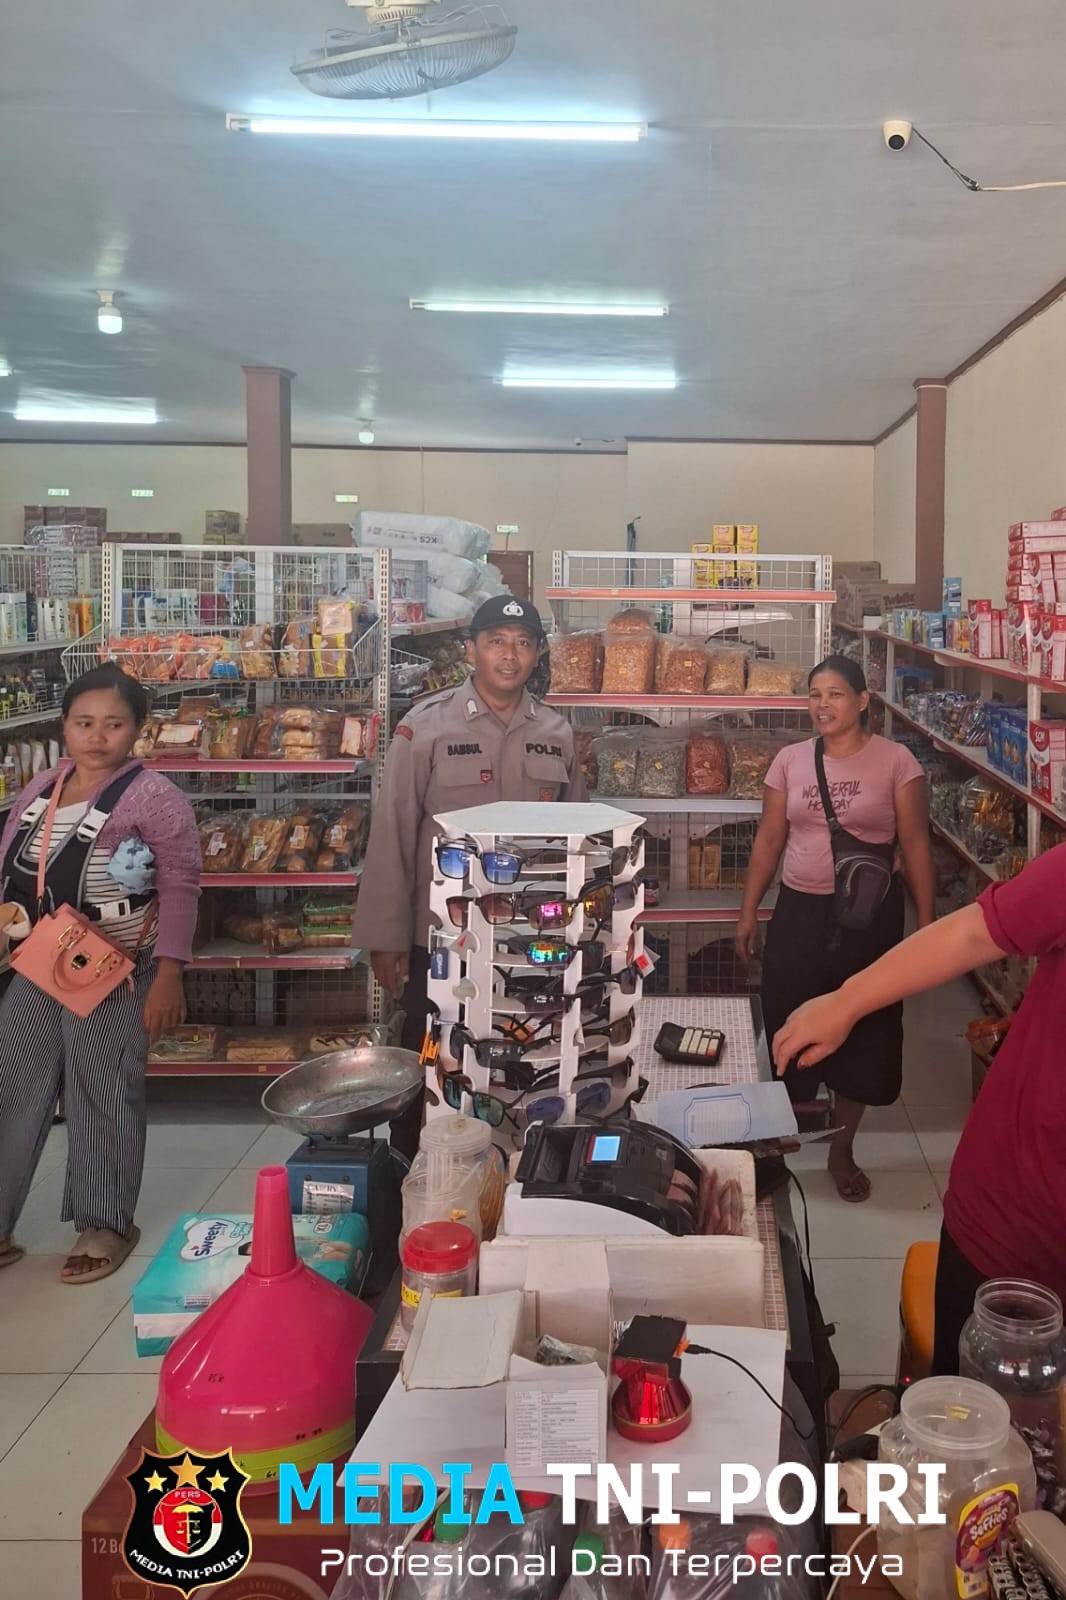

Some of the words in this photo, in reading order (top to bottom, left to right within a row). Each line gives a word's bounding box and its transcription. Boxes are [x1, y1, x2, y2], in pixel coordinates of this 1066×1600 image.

[525, 742, 562, 757] POLRI
[802, 780, 861, 799] WOERFUL
[807, 798, 853, 811] HODAY
[194, 1221, 228, 1256] Sweety
[91, 1537, 107, 1554] 12
